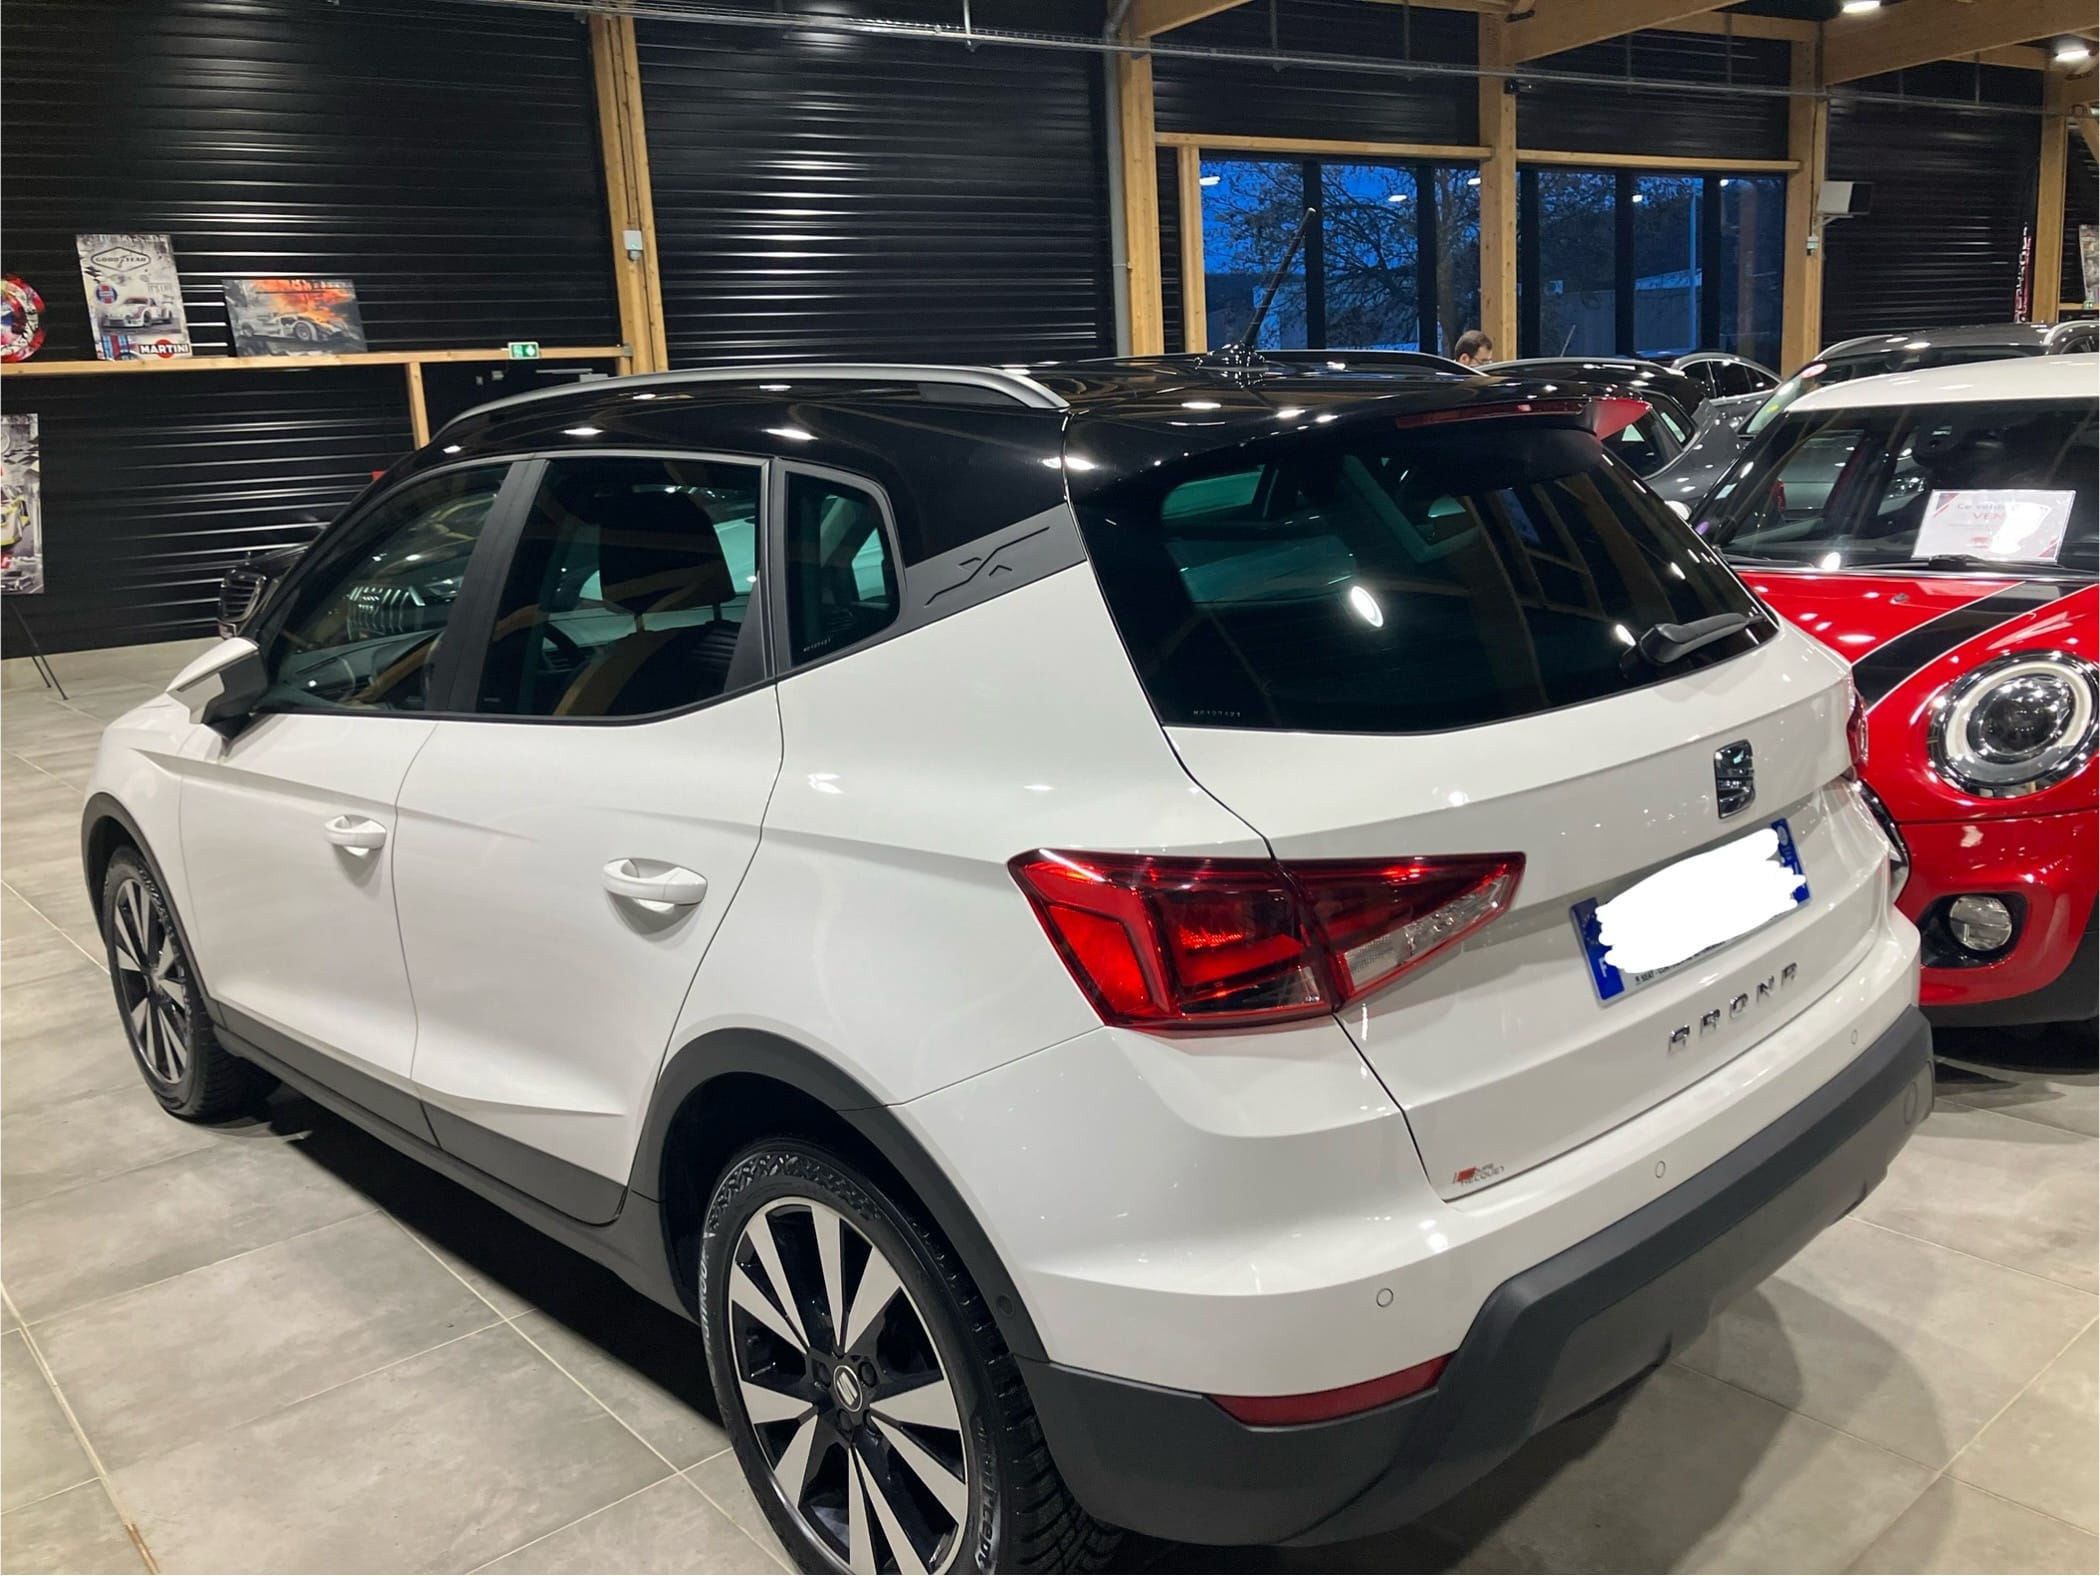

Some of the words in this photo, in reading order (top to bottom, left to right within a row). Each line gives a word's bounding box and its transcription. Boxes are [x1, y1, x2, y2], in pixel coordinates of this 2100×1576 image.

[140, 344, 189, 354] MARTINI
[1972, 512, 2006, 520] VEN
[1668, 962, 1797, 1054] ARONA
